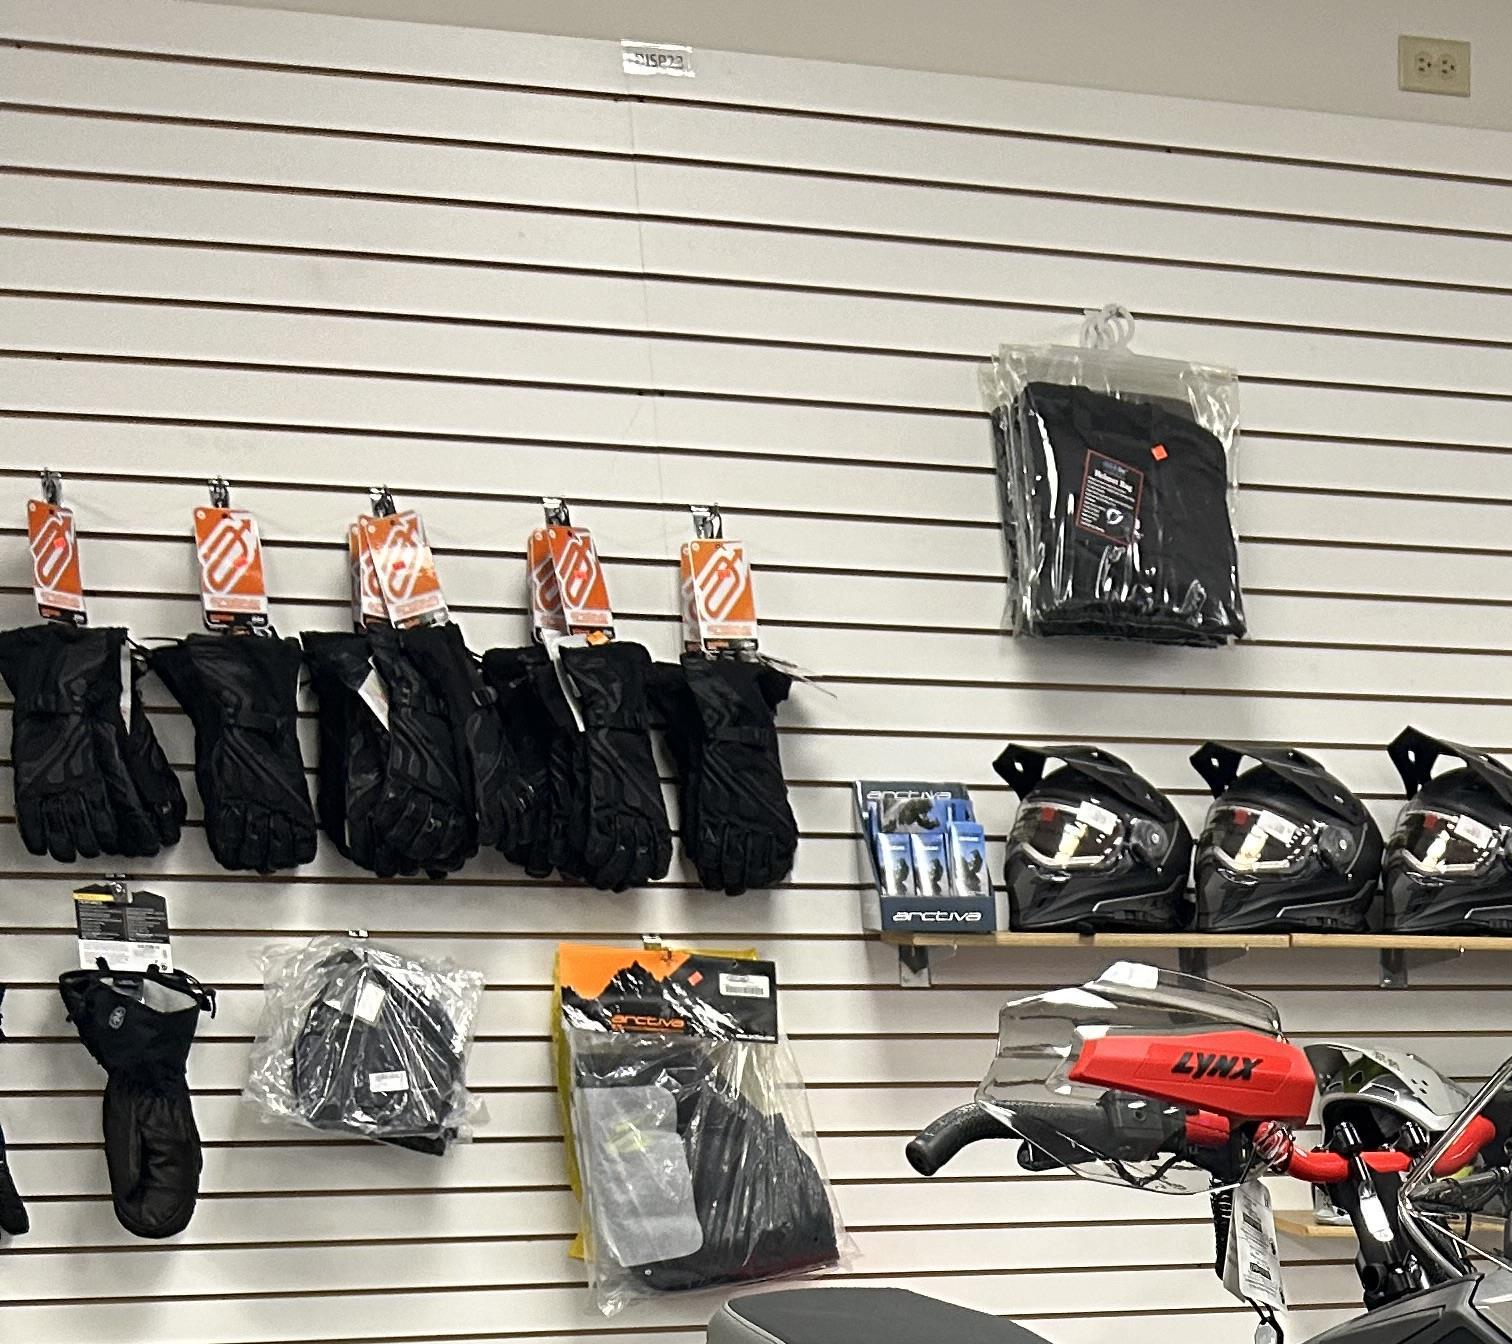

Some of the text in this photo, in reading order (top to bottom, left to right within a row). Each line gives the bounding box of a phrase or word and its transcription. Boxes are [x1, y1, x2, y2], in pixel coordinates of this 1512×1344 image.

[892, 910, 982, 922] arctiva
[611, 1013, 685, 1028] arctiva
[1171, 1051, 1264, 1081] LYNX
